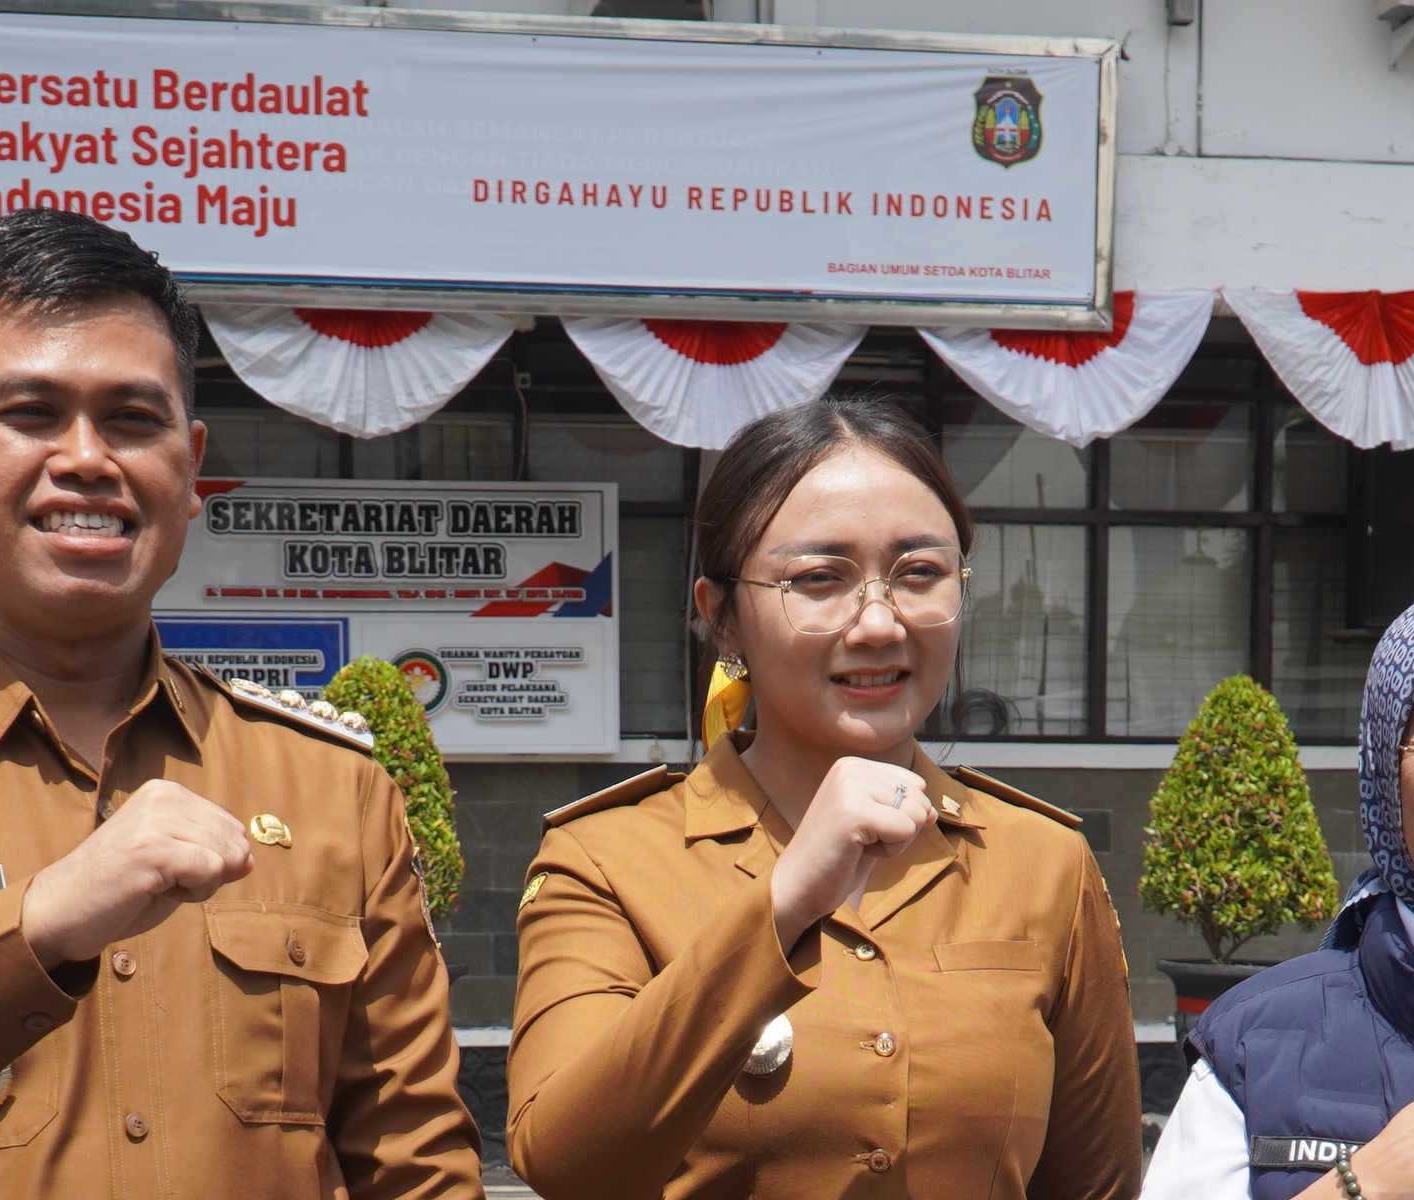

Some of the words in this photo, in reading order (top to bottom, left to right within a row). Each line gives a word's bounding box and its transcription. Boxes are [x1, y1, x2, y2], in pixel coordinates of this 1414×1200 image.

[153, 69, 369, 117] Berdaulat
[132, 125, 347, 179] Sejahtera
[474, 178, 669, 209] DIRGAHAYU
[688, 186, 854, 216] REPUBLIK
[873, 192, 1054, 223] INDONESIA
[197, 184, 297, 237] Maju
[828, 262, 877, 274] BAGIAN
[881, 264, 920, 275] UMUM
[923, 265, 965, 277] SETDA
[969, 267, 1003, 278] KOTA
[1007, 268, 1051, 279] BLITAR
[208, 499, 440, 534] SEKRETARIAT
[451, 502, 578, 535] DAERAH
[287, 542, 375, 575] KOTA
[386, 545, 504, 576] BLITAR
[207, 654, 259, 665] REPUBLIK
[263, 655, 318, 665] INDONESIA
[440, 650, 480, 659] DHARMA
[484, 650, 520, 659] WANITA
[524, 650, 581, 659] PERSATUAN
[488, 661, 534, 679] DWP
[466, 683, 498, 692] UNSUR
[501, 683, 556, 692] PELAKSANA
[458, 695, 524, 703] SEKRETARIAT
[528, 695, 565, 703] DAERAH
[480, 707, 505, 715] KOTA
[508, 707, 543, 715] BLITAR
